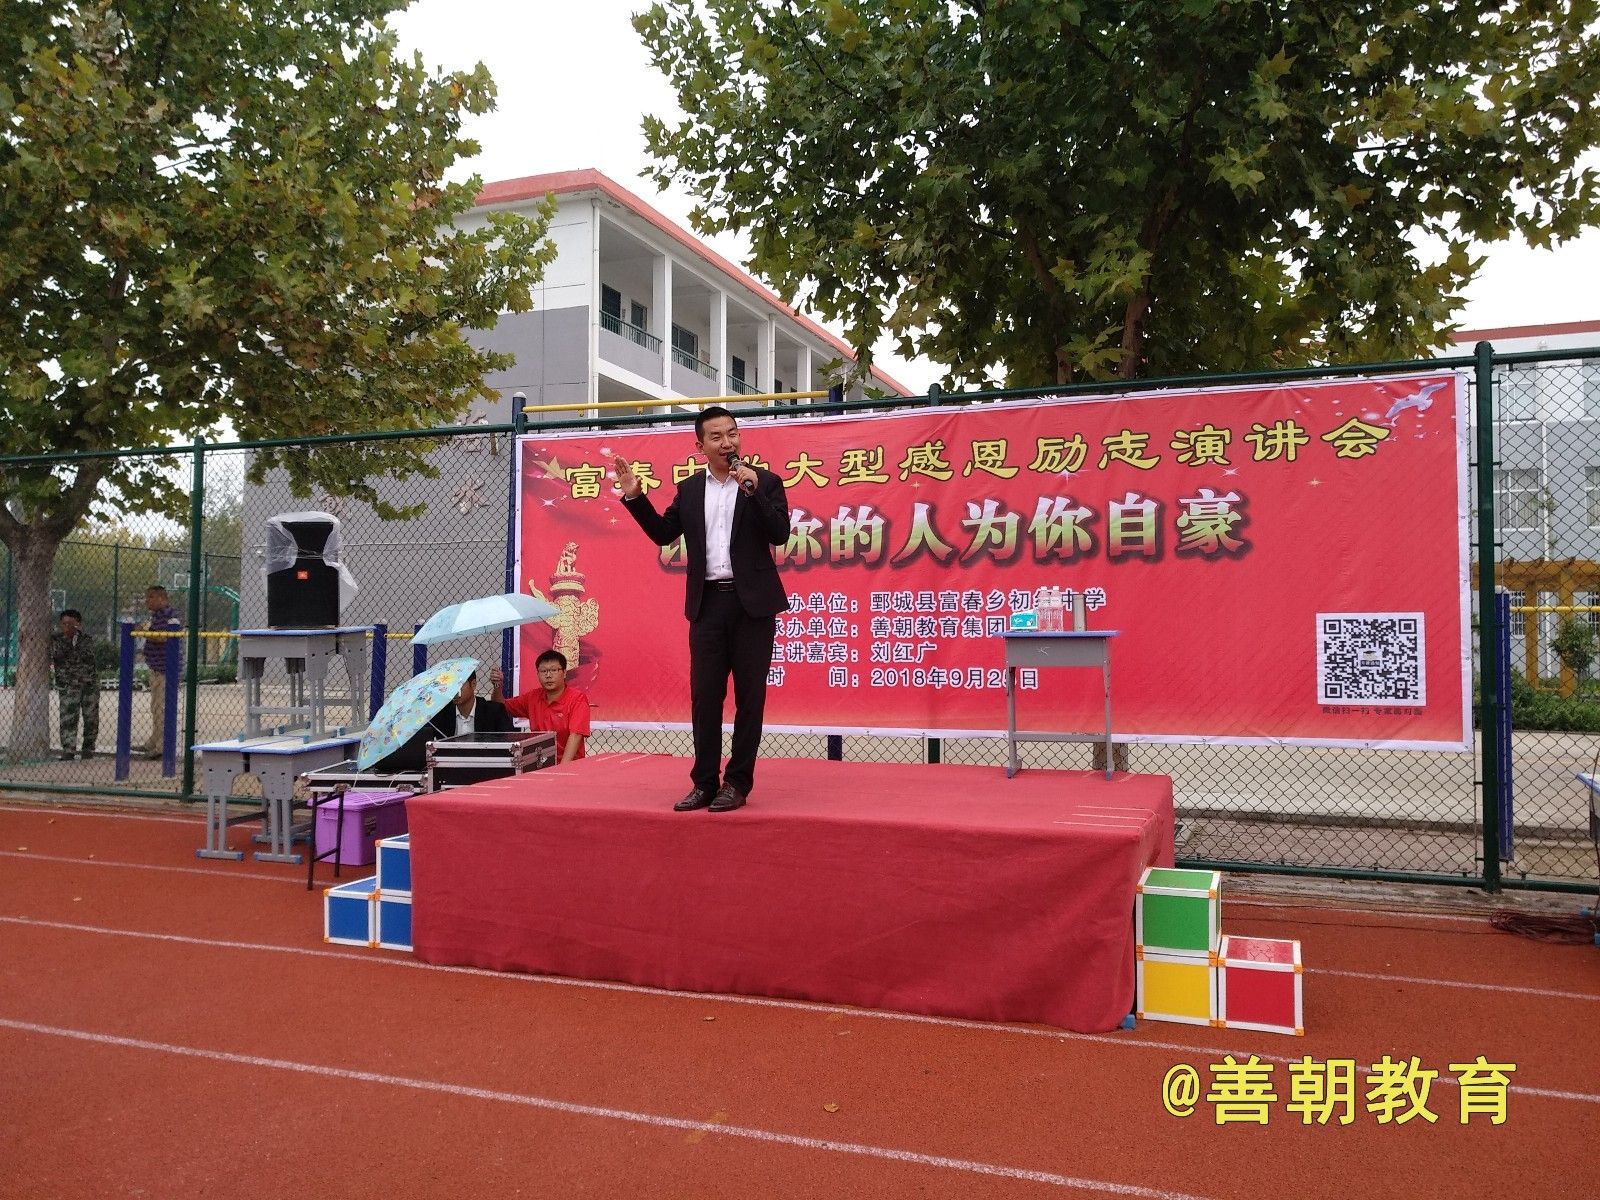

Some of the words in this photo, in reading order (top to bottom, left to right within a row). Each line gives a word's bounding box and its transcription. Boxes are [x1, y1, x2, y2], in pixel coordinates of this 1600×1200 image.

[565, 418, 1391, 500] 富春中大型感恩励志演讲会
[660, 487, 1246, 567] 你的人为你自豪
